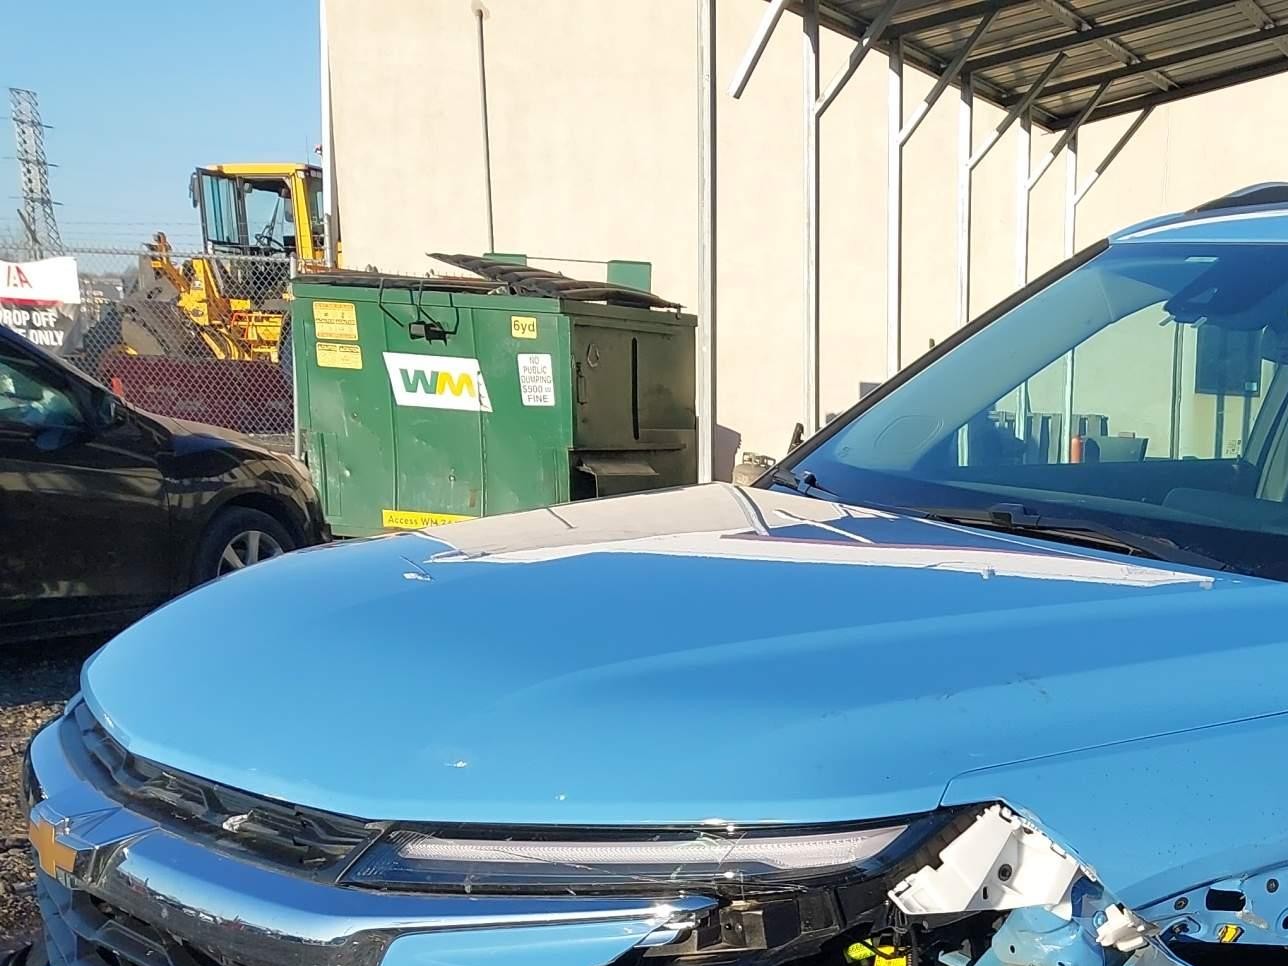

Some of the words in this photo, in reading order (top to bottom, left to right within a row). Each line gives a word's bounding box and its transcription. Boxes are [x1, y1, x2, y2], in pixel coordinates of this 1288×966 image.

[0, 308, 31, 326] ROP
[32, 310, 58, 329] OFF
[513, 319, 536, 335] 6yd
[29, 329, 65, 346] ONLY
[528, 356, 540, 365] NO
[523, 365, 548, 374] PUBLIC
[399, 368, 477, 398] WM
[520, 375, 552, 384] DUMPING
[527, 394, 551, 403] FINE
[387, 515, 418, 525] Access
